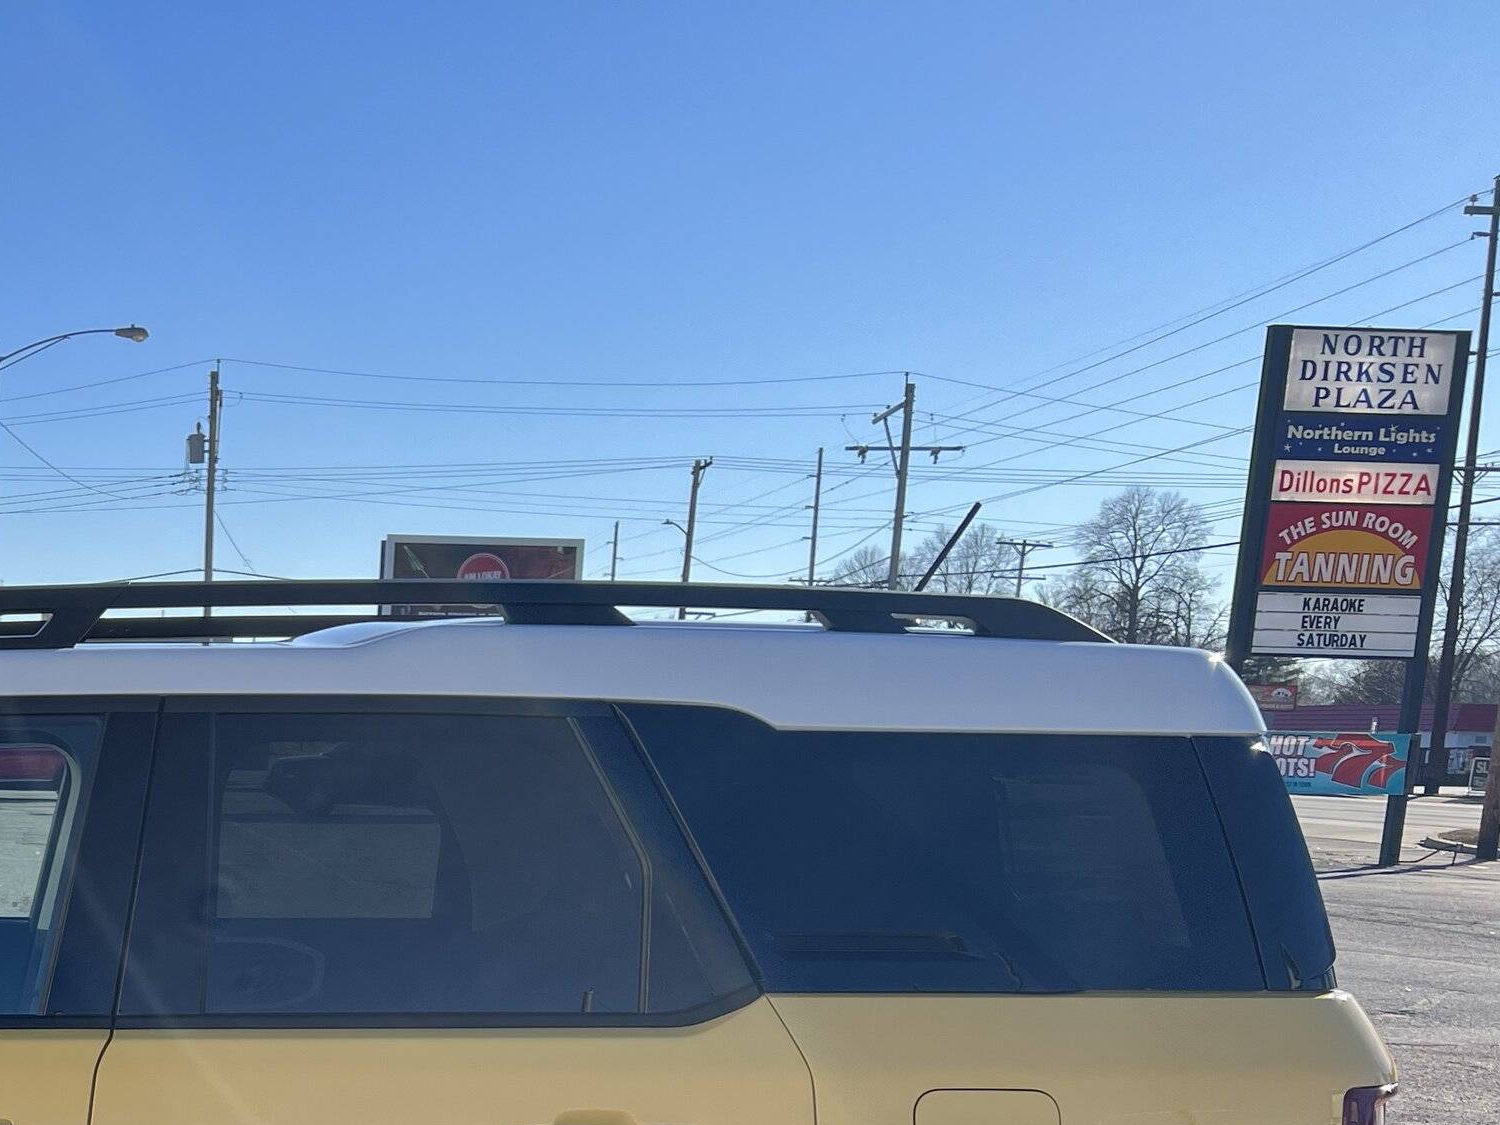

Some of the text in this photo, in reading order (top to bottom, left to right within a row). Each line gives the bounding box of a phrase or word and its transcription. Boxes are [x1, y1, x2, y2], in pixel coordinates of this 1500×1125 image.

[1320, 334, 1428, 358] NORTH
[1299, 359, 1444, 385] DIRKSEN
[1311, 386, 1421, 411] PLAZA
[1287, 425, 1436, 445] Northern Lights
[1333, 443, 1386, 456] Lounge
[1278, 510, 1419, 550] THE SUN ROOM
[1274, 550, 1416, 586] TANNING
[1302, 597, 1365, 613] KARAOKE
[1300, 615, 1341, 630] EVERY
[1296, 633, 1367, 648] SATURDAY
[1270, 734, 1310, 756] HOT
